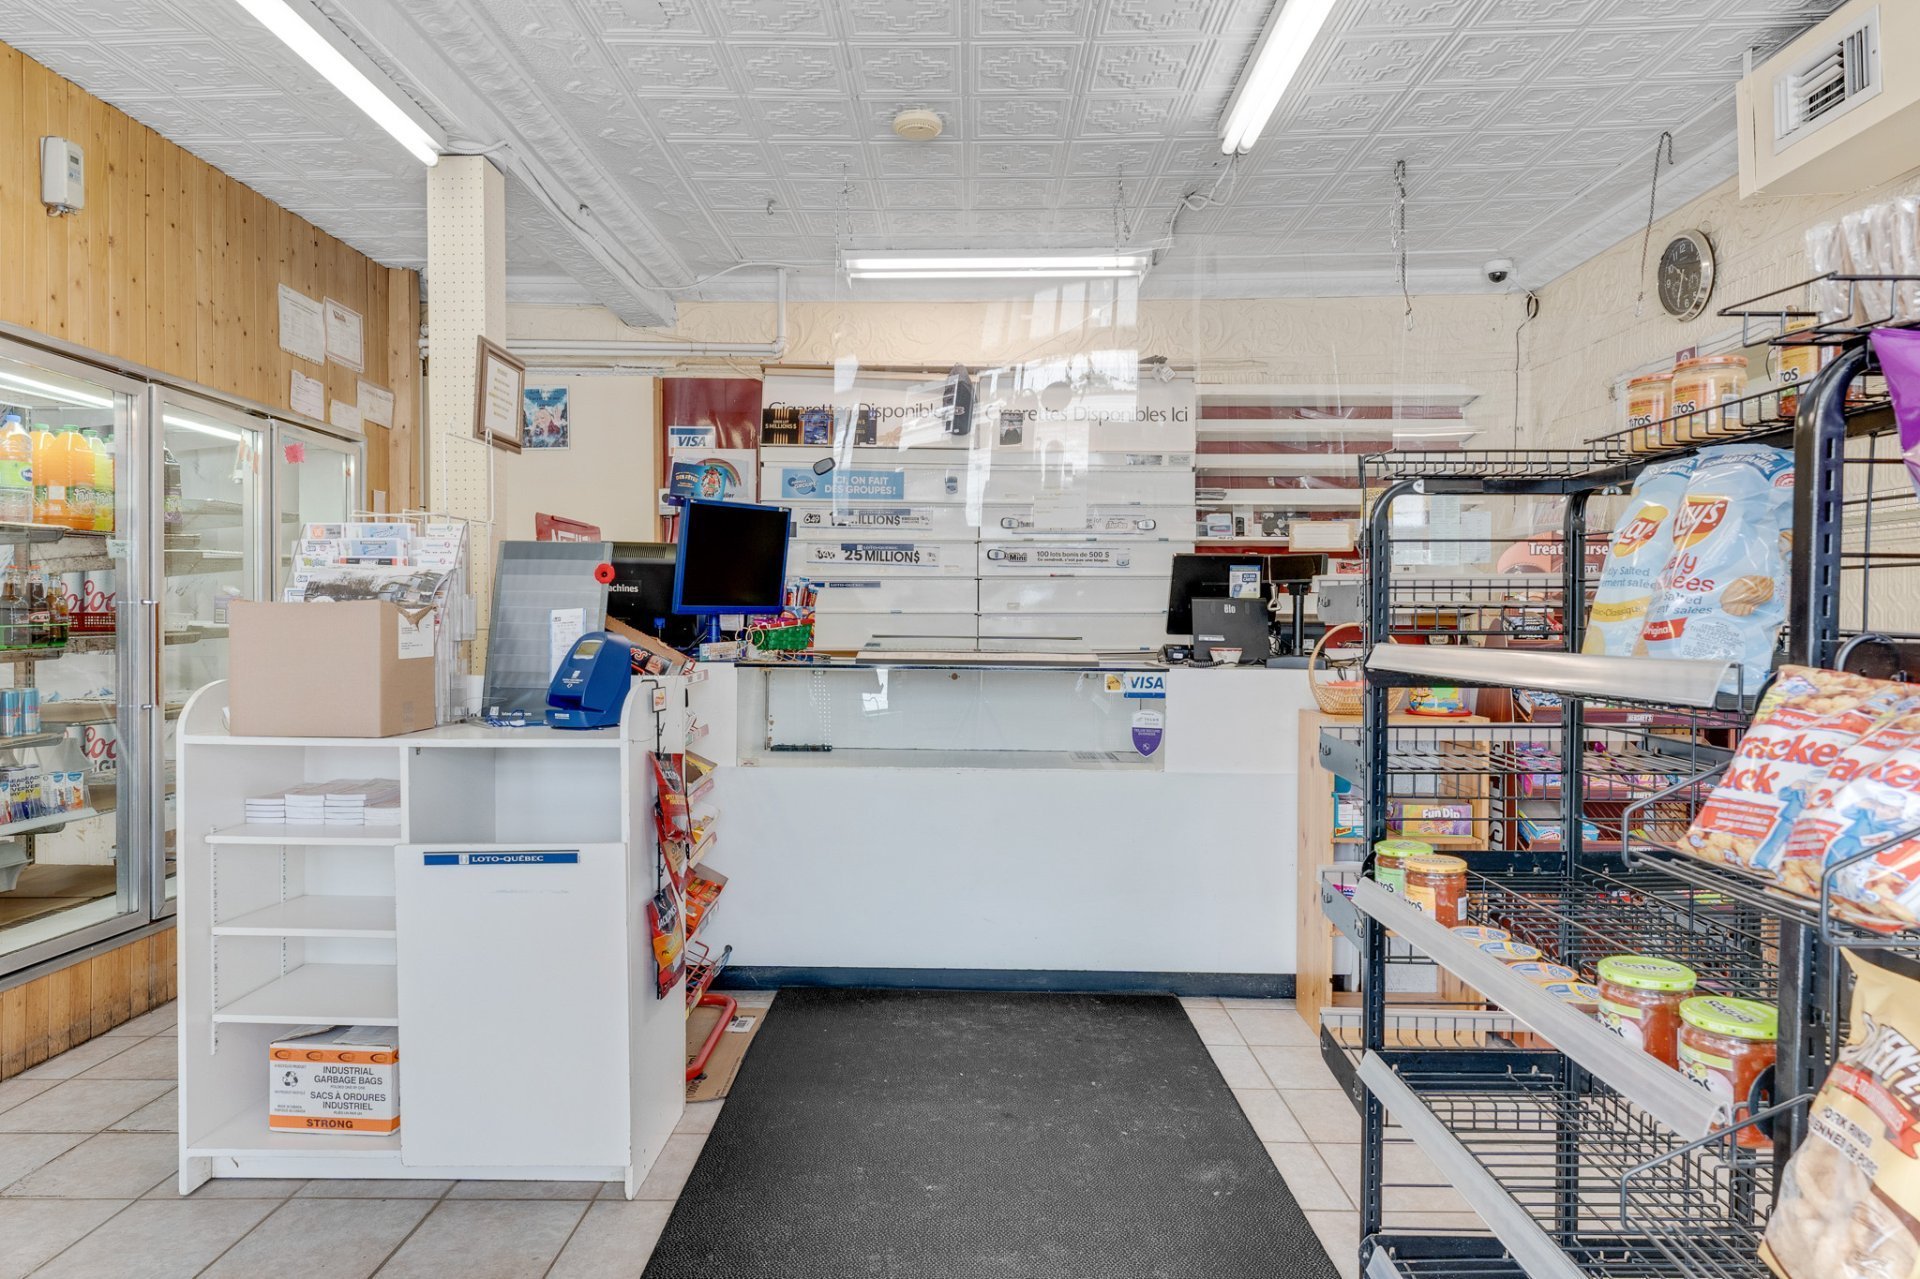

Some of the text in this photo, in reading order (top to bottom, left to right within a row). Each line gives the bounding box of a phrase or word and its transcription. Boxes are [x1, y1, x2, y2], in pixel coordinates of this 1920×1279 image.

[1171, 406, 1188, 422] Ici
[678, 436, 706, 447] VISA
[850, 475, 866, 485] ON
[868, 476, 889, 485] FAIT
[824, 484, 843, 494] DES
[1529, 542, 1564, 555] Treat
[844, 549, 863, 561] 25
[864, 550, 920, 564] MILLION$
[1089, 551, 1104, 559] 500
[1619, 566, 1651, 577] Salted
[608, 583, 639, 592] achines
[1643, 625, 1673, 639] Original
[1130, 676, 1164, 689] VISA
[1423, 807, 1461, 819] Fun Dip
[471, 854, 544, 863] LOTO-QUÉBEC
[322, 1066, 374, 1076] INDUSTRIAL
[313, 1075, 383, 1086] GARBAGE BAGS
[310, 1090, 386, 1102] SACS À ORDURES
[322, 1102, 374, 1111] INDUSTRIEL
[306, 1118, 354, 1129] STRONG
